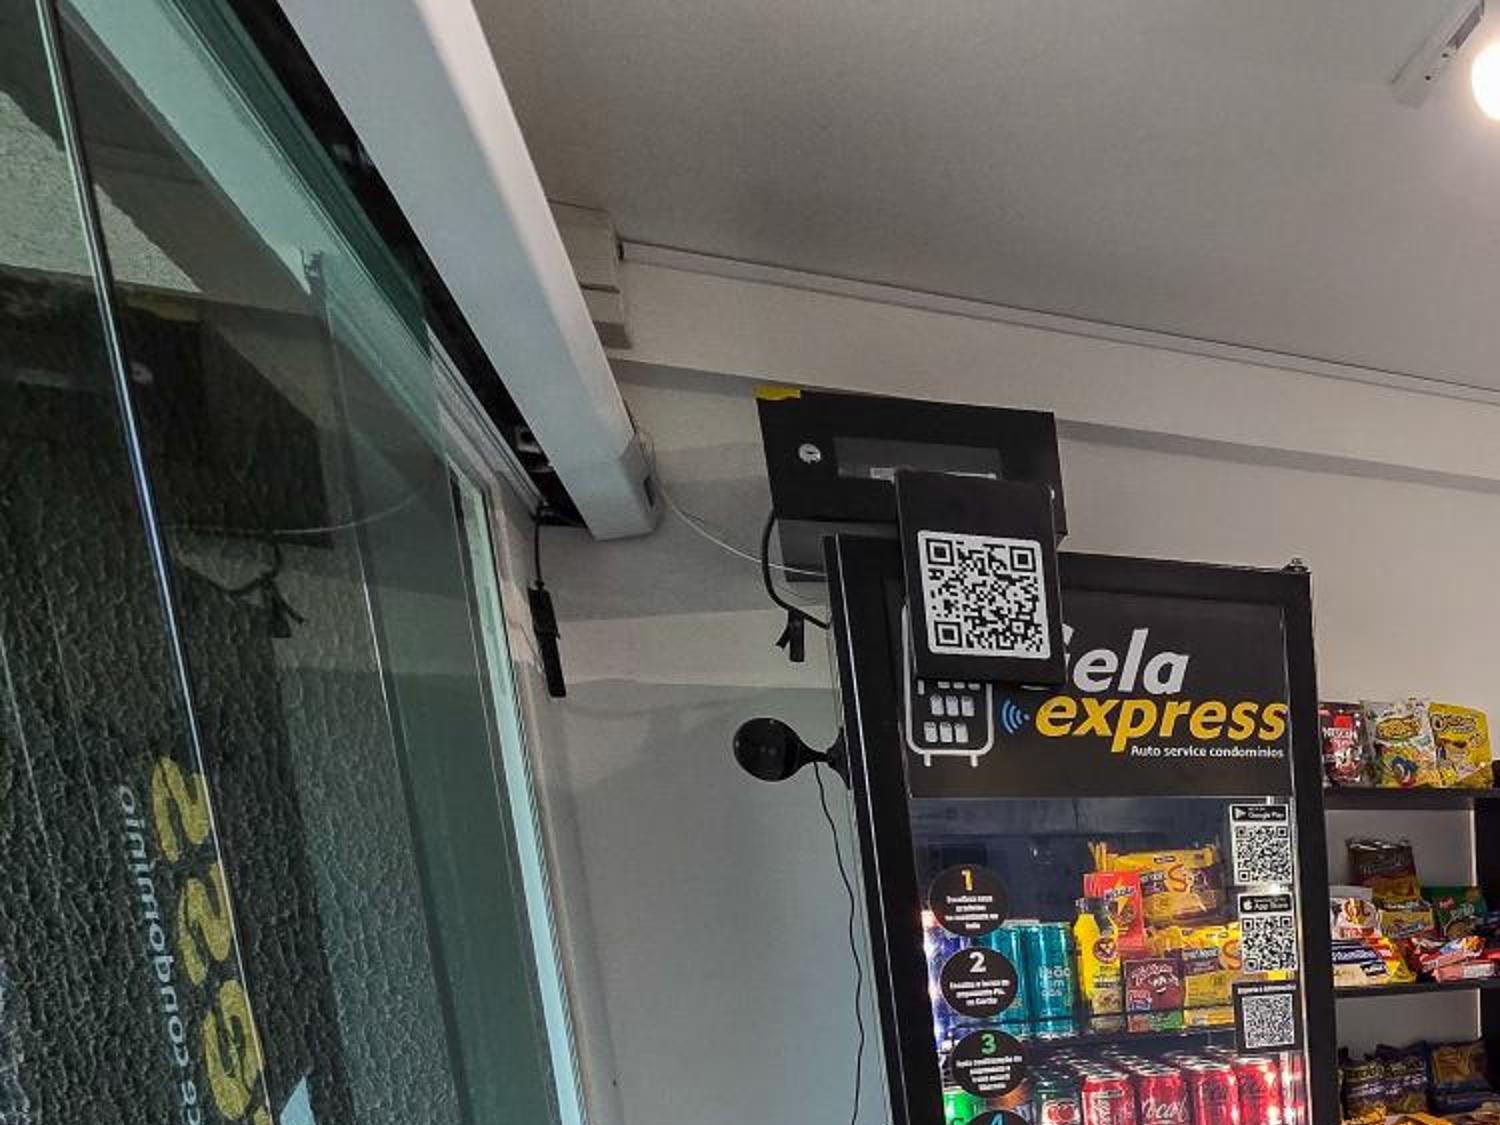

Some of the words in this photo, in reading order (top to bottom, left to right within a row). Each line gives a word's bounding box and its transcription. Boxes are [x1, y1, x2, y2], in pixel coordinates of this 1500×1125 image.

[1062, 625, 1189, 694] ela
[1036, 696, 1288, 752] express
[1131, 745, 1161, 757] Auto
[1163, 745, 1207, 757] service
[961, 869, 973, 891] 1
[969, 951, 987, 973] 2
[981, 1033, 997, 1055] 3
